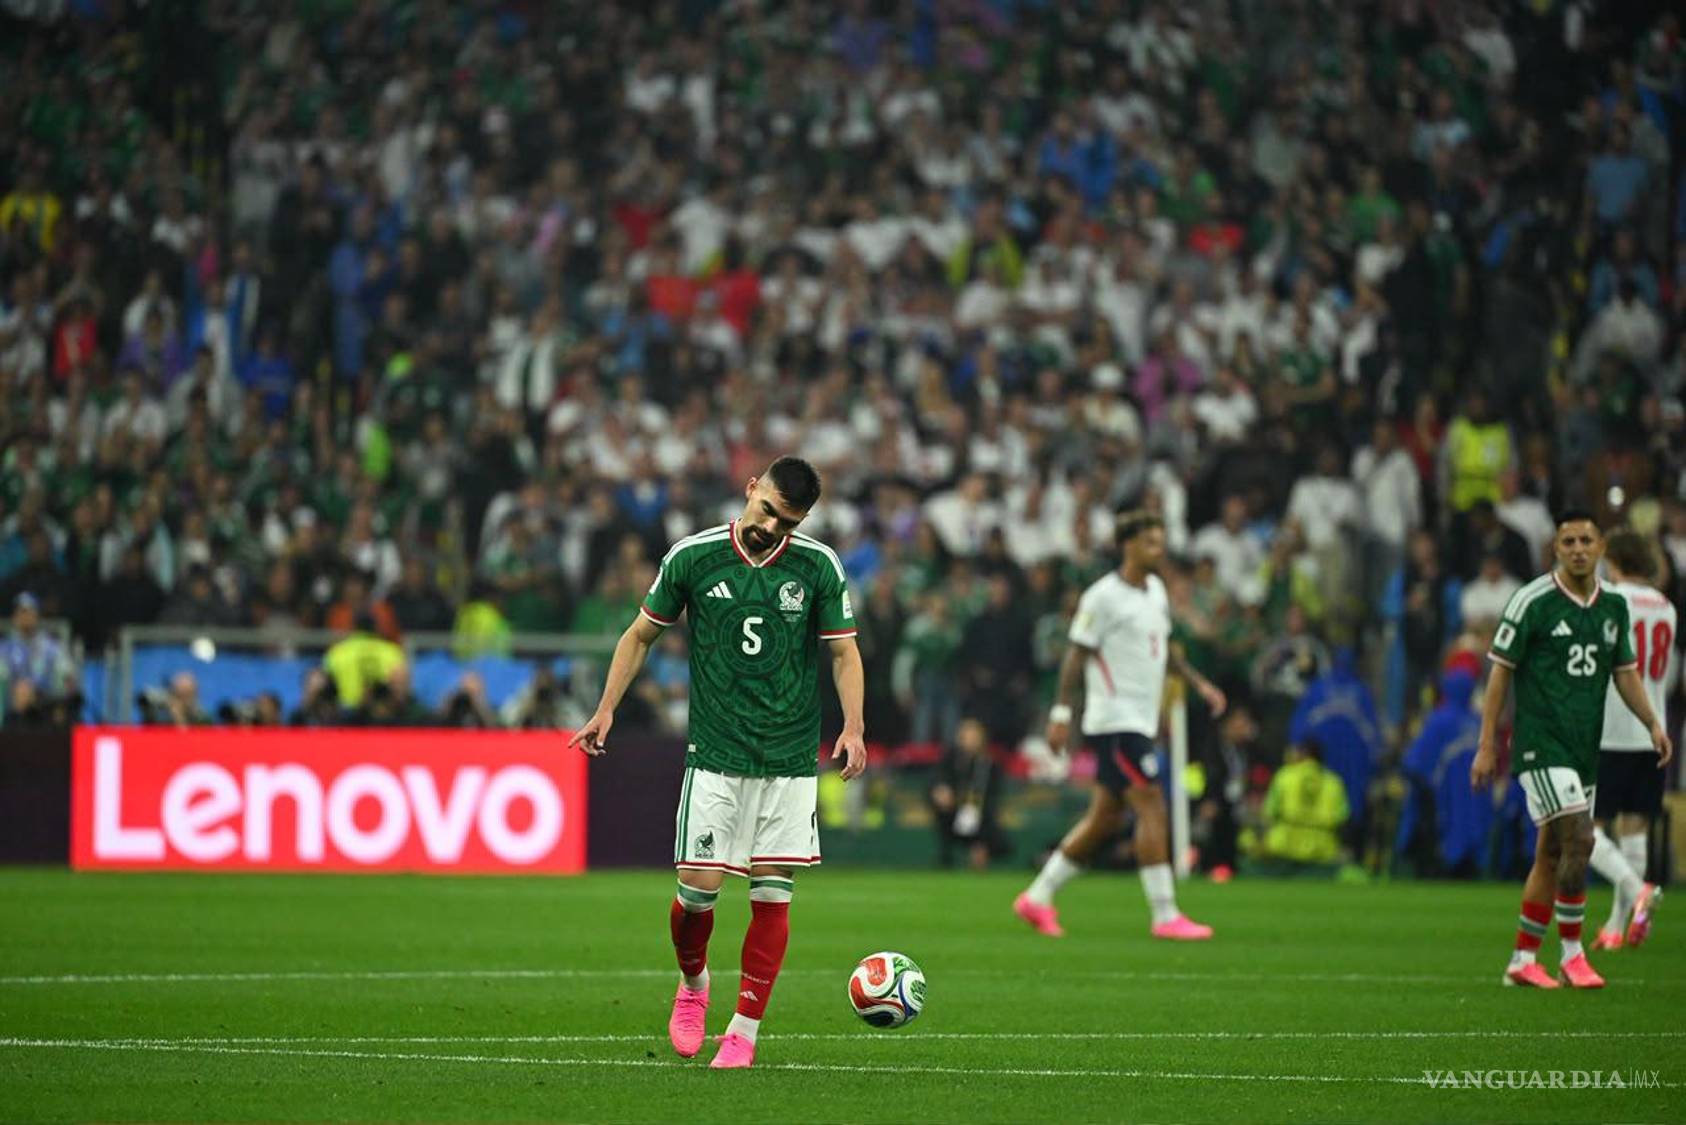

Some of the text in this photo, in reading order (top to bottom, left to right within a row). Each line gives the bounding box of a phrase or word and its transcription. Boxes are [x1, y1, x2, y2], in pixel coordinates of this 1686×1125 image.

[742, 616, 763, 655] 5
[1567, 643, 1598, 676] 25
[1634, 619, 1672, 681] 18
[94, 737, 565, 864] Lenovo
